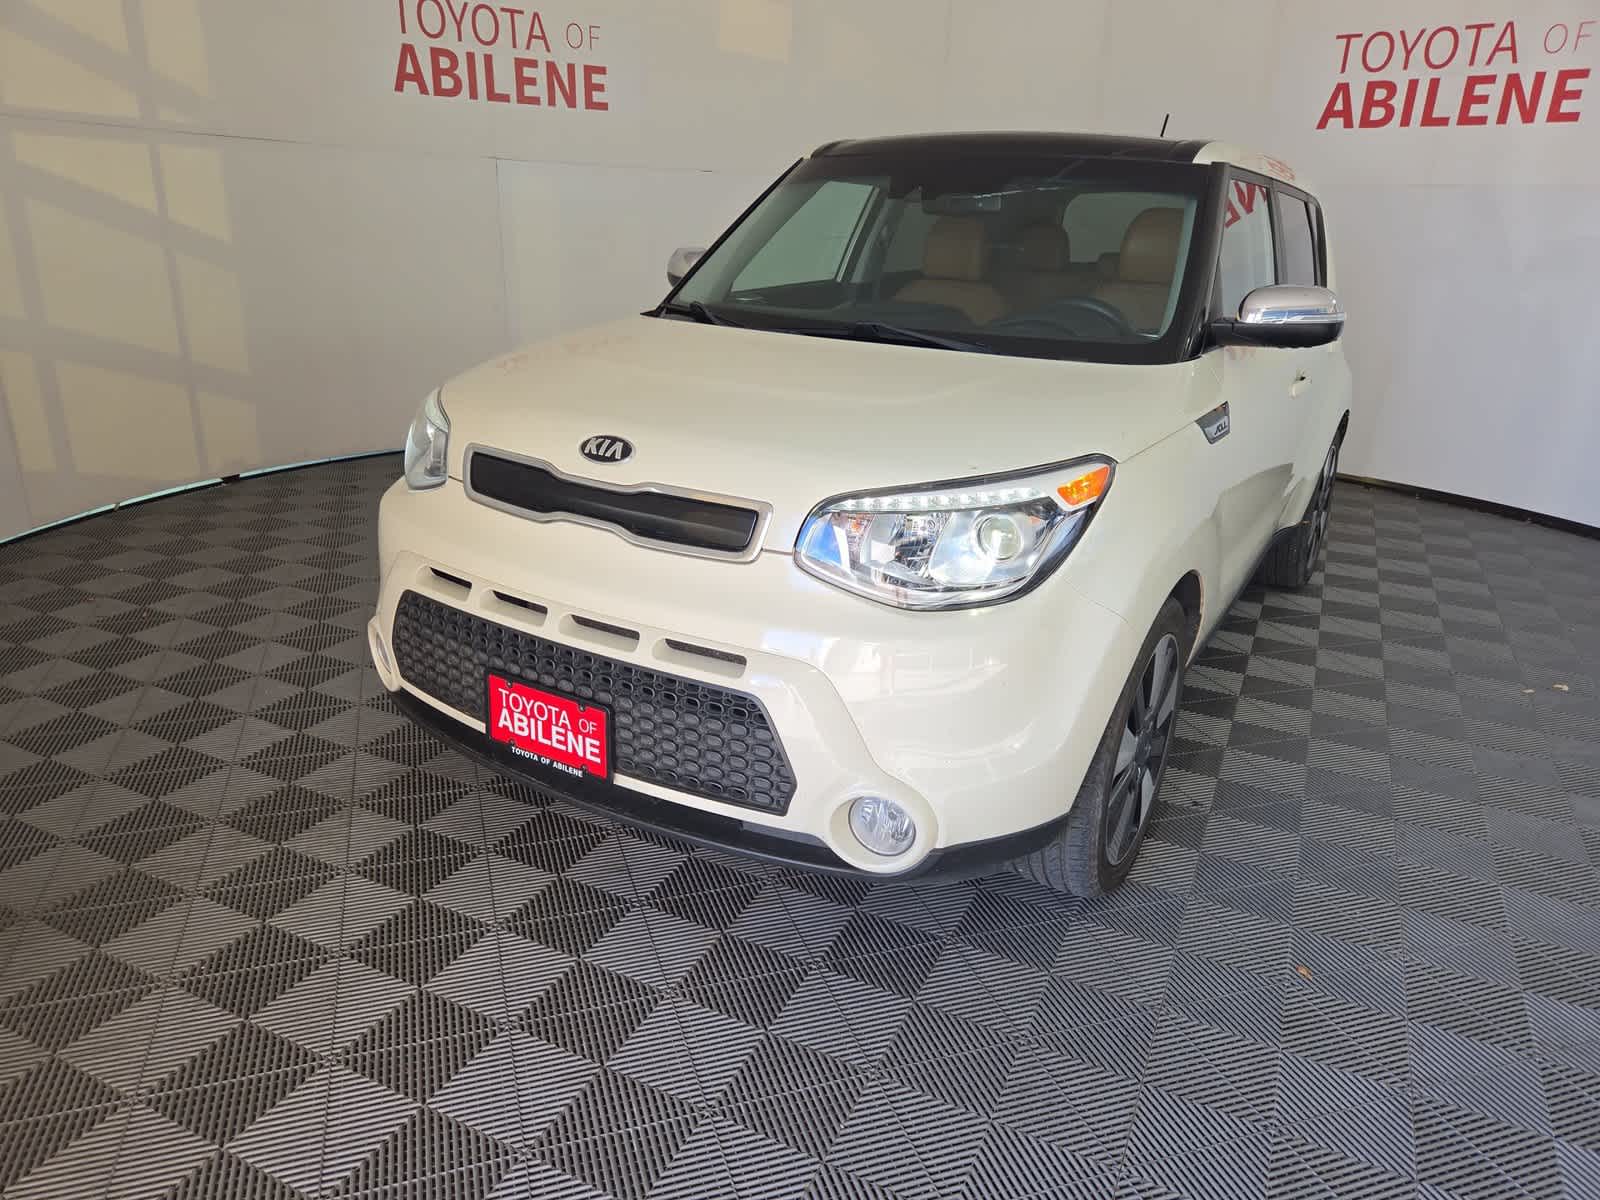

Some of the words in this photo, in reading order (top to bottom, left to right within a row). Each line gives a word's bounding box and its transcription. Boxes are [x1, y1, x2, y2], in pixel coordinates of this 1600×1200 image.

[566, 22, 600, 50] OF
[1335, 20, 1518, 74] TOYOTA
[1543, 20, 1599, 55] OF
[394, 43, 609, 111] ABILENE
[1315, 68, 1591, 130] ABILENE
[583, 437, 624, 460] KIA
[498, 687, 572, 731] TOYOTA
[578, 718, 598, 734] OF
[498, 707, 601, 764] ABILENE
[511, 746, 539, 762] TOYOTA
[541, 756, 551, 766] OF
[552, 761, 583, 778] ABILENE
